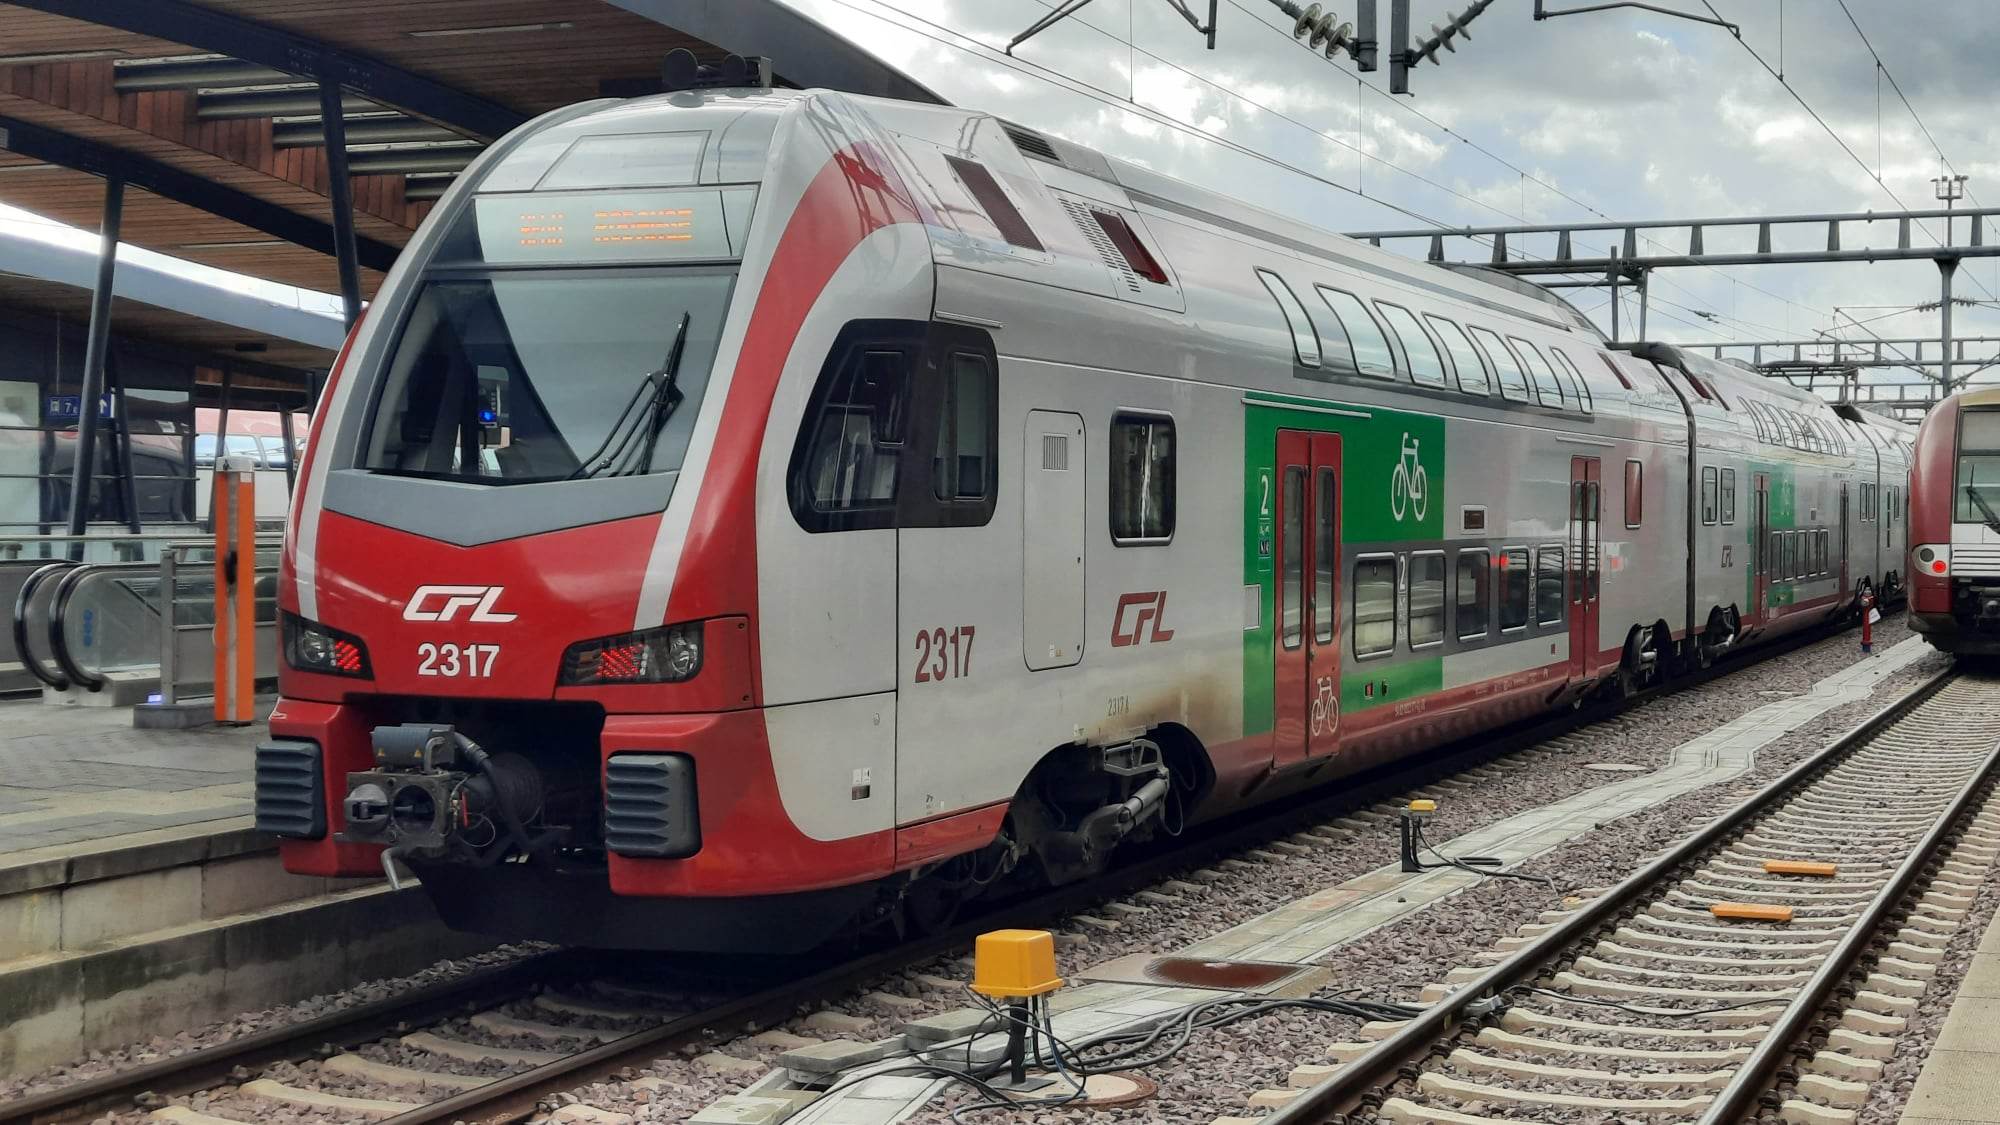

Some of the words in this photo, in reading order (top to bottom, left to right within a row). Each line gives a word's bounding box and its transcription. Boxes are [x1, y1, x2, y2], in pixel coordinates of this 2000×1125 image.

[1261, 475, 1269, 515] 2
[1400, 555, 1406, 590] 2
[403, 585, 518, 623] CFL
[1111, 591, 1174, 647] CFL
[418, 642, 500, 677] 2317
[915, 626, 975, 683] 2317
